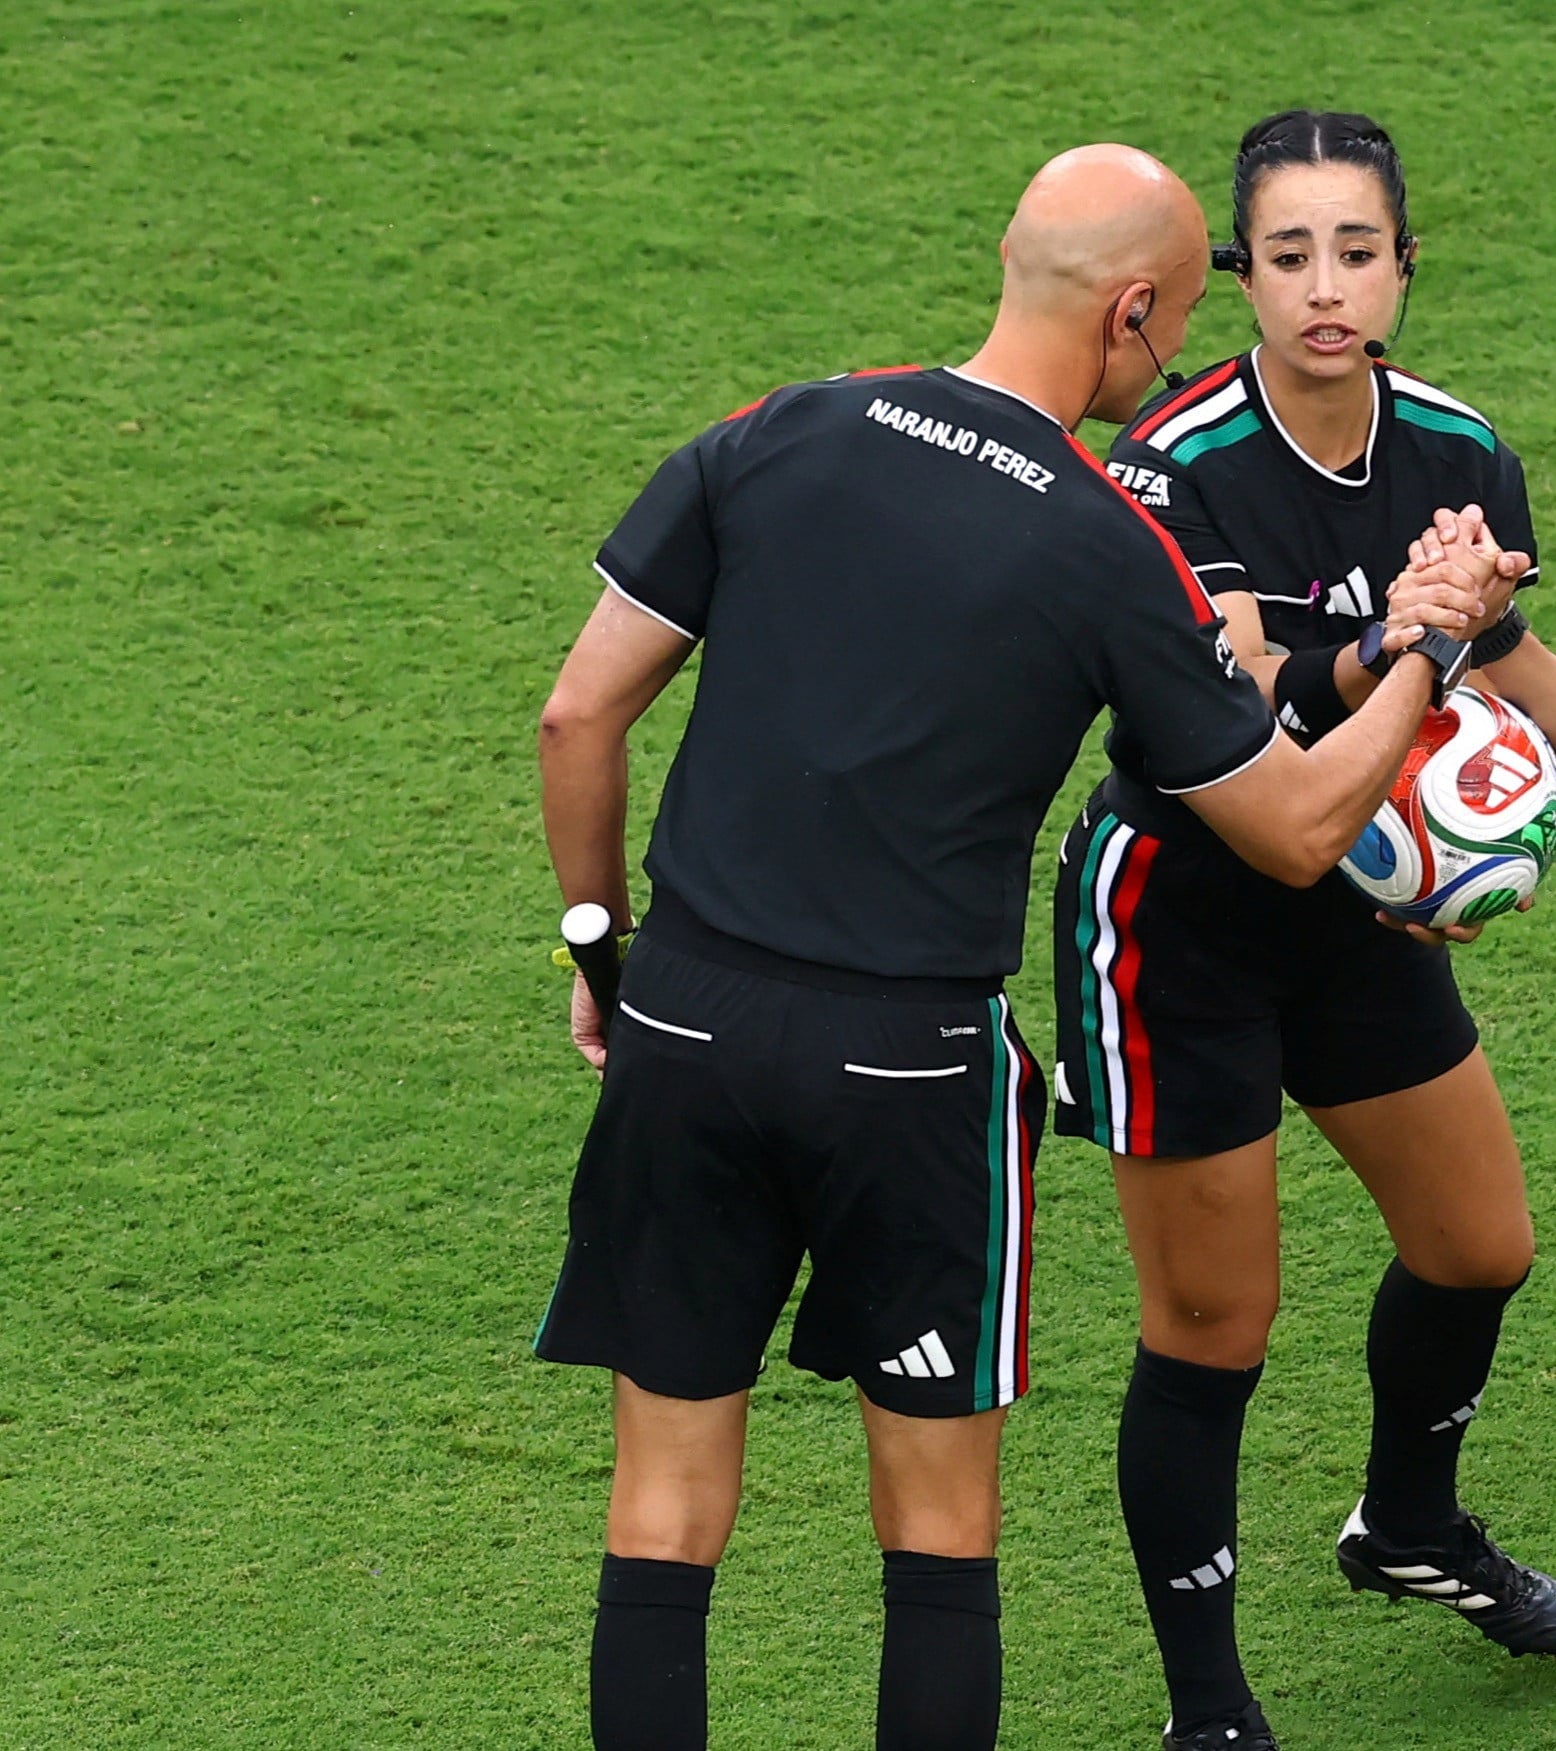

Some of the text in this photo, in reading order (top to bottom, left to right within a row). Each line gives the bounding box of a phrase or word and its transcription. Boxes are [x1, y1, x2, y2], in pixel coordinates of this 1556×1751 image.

[865, 398, 1056, 494] NARANJO PEREZ
[1106, 461, 1169, 502] FIFA
